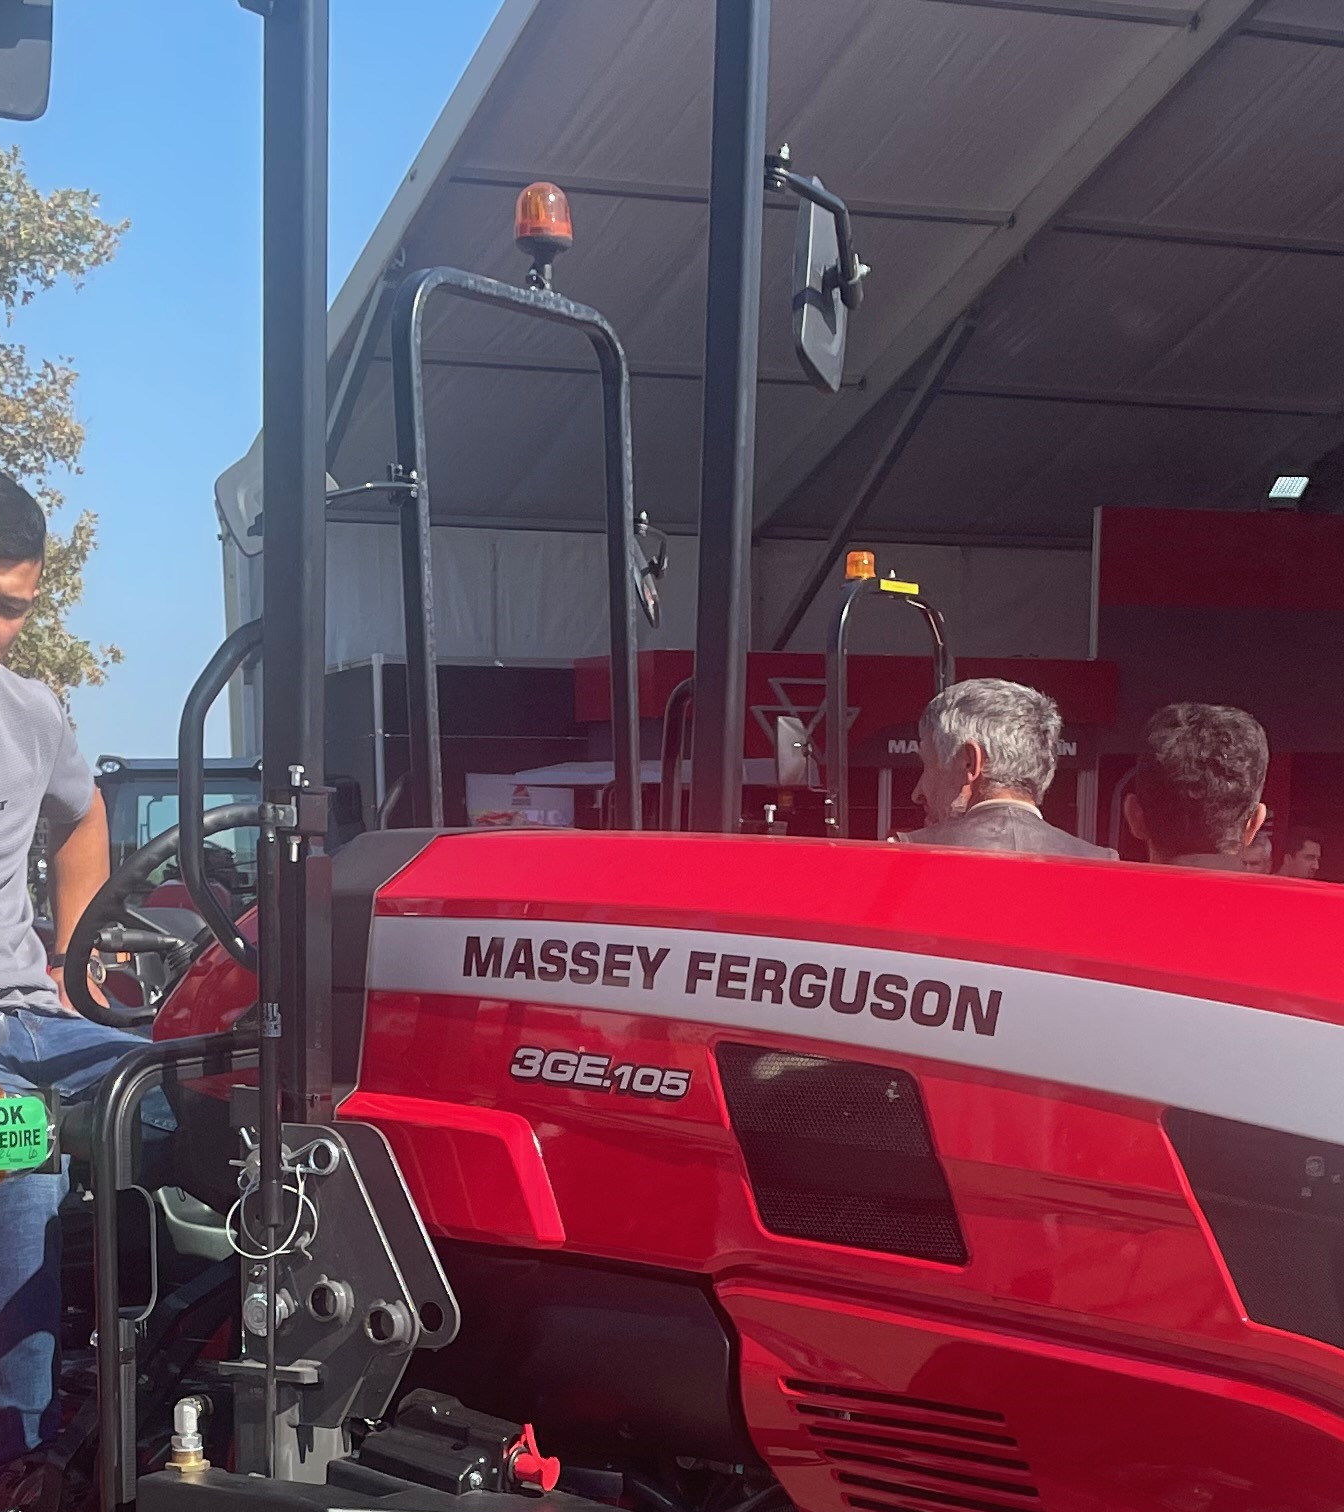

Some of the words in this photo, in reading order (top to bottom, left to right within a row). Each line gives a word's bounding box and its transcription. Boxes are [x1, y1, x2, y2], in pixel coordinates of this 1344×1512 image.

[462, 936, 670, 990] MASSEY
[685, 950, 1002, 1037] FERGUSON
[510, 1046, 692, 1099] 3GE.105
